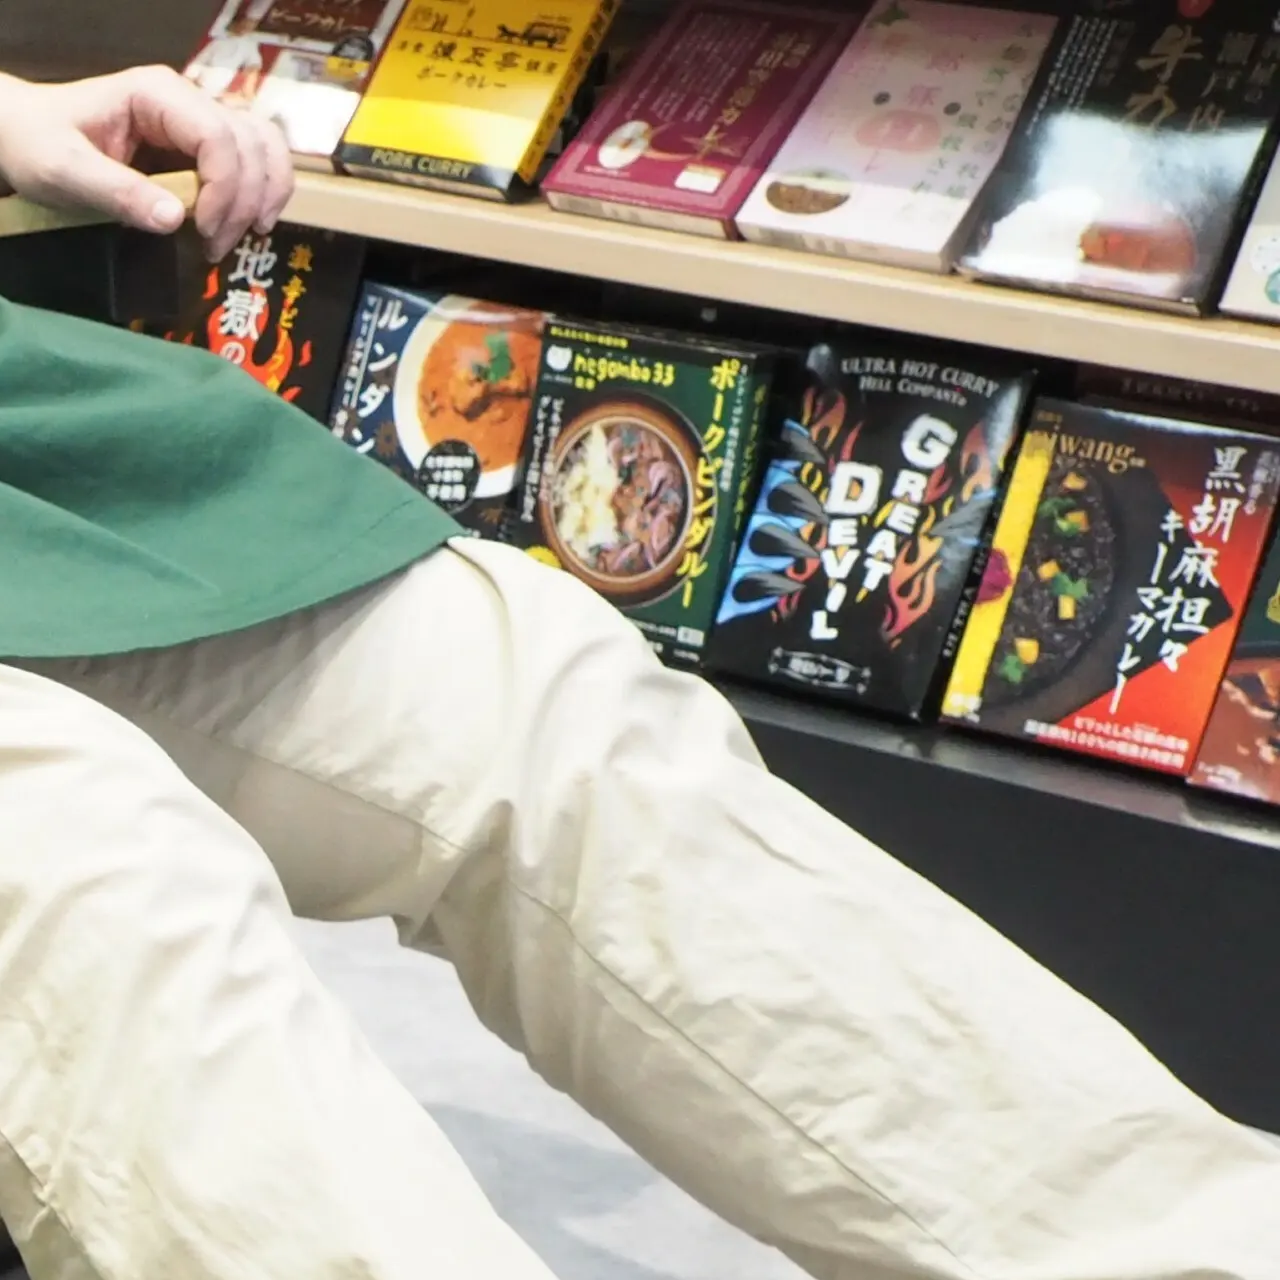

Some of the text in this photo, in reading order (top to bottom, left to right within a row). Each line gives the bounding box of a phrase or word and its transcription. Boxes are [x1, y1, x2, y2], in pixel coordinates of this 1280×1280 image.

[370, 149, 474, 179] PORK CURRY
[841, 357, 999, 398] ULTRA HOT CURRY
[676, 358, 741, 608] ポークビンダルー
[810, 460, 883, 640] DEVIL
[864, 413, 958, 592] GREAT
[1159, 446, 1248, 673] 黒胡麻担々
[1108, 508, 1184, 715] キーマカレー
